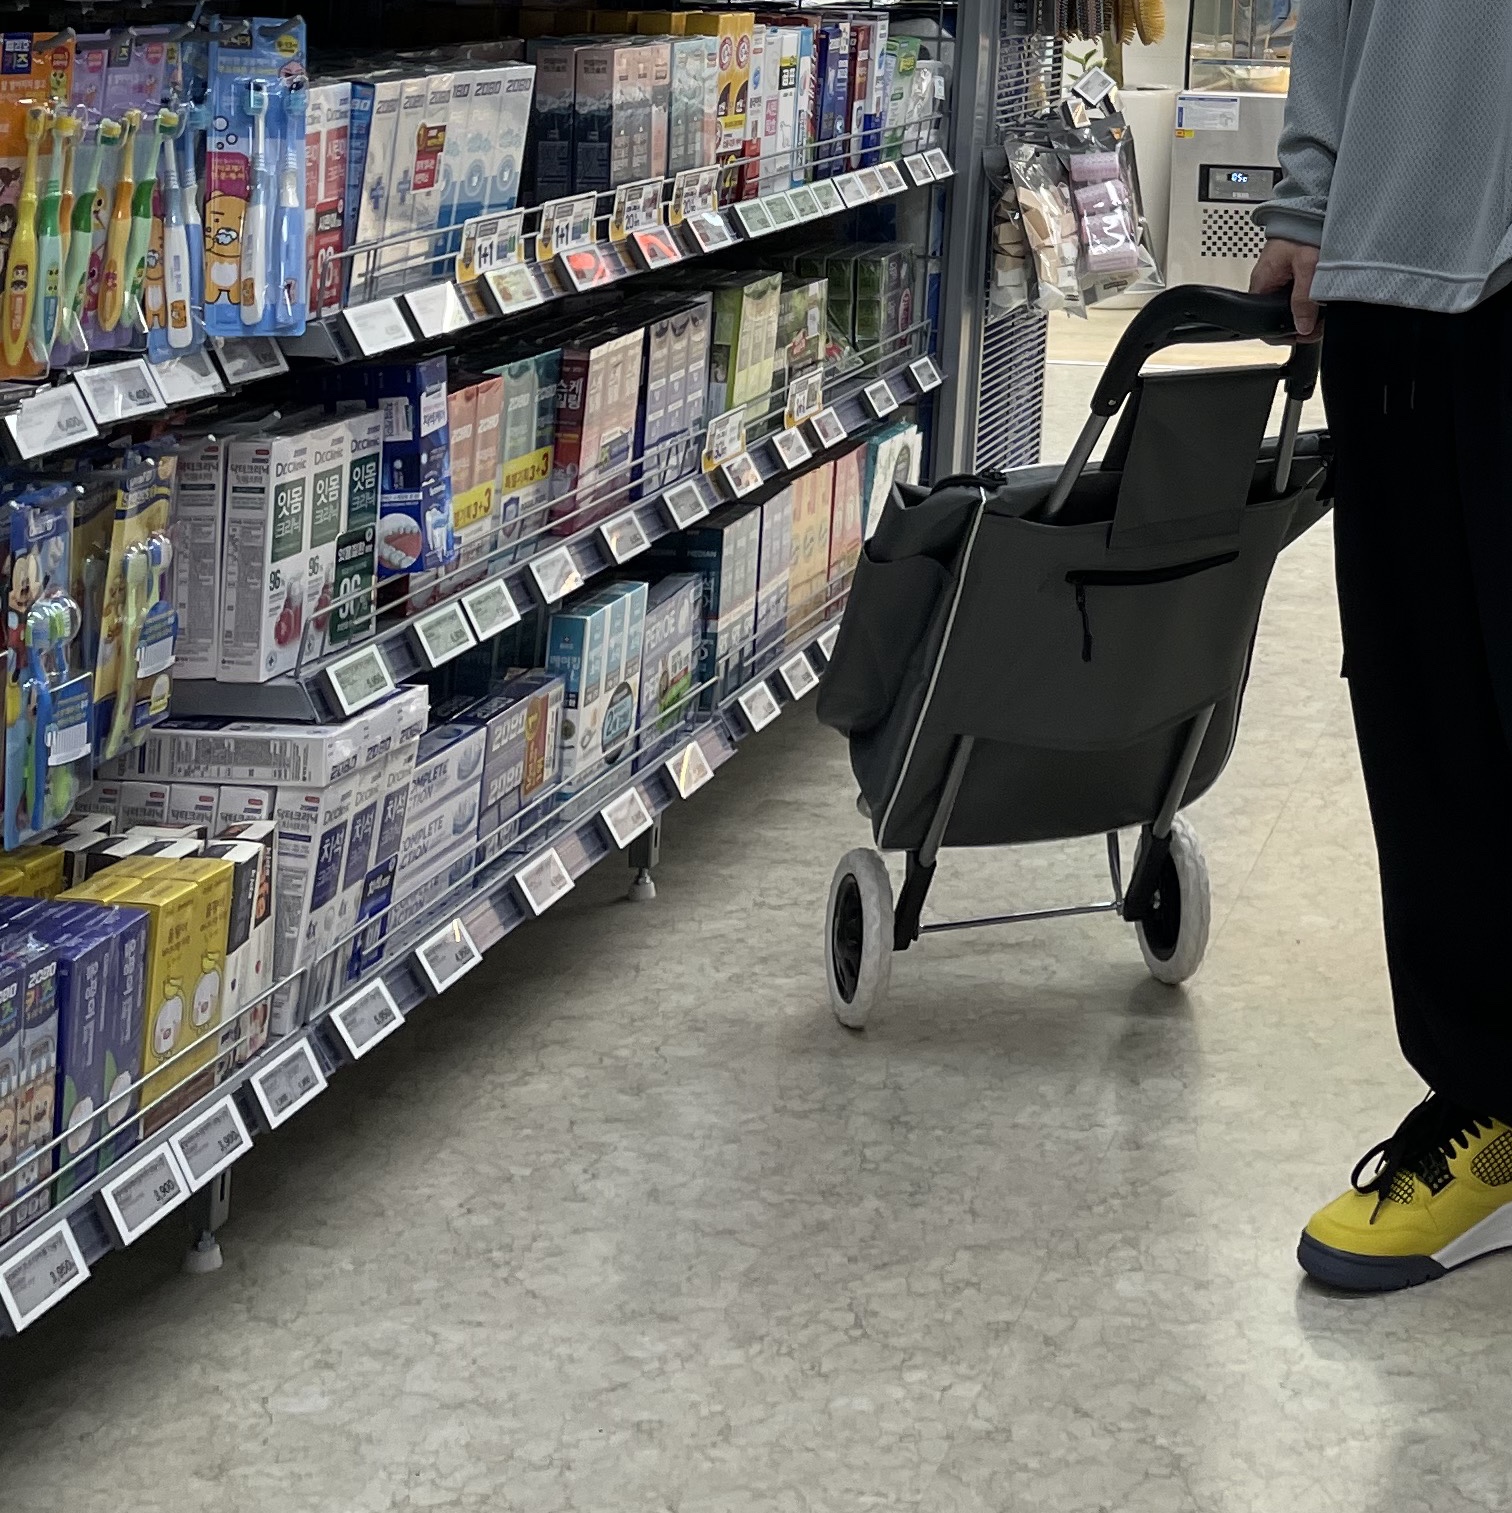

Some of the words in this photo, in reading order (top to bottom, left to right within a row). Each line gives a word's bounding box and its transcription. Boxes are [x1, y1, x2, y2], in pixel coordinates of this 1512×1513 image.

[474, 80, 501, 96] 2080
[506, 78, 532, 93] 2080
[478, 240, 494, 274] 1+1
[316, 474, 341, 505] 잇몸
[352, 462, 378, 492] 잇몸
[277, 486, 304, 518] 잇몸
[366, 737, 391, 761] 2080
